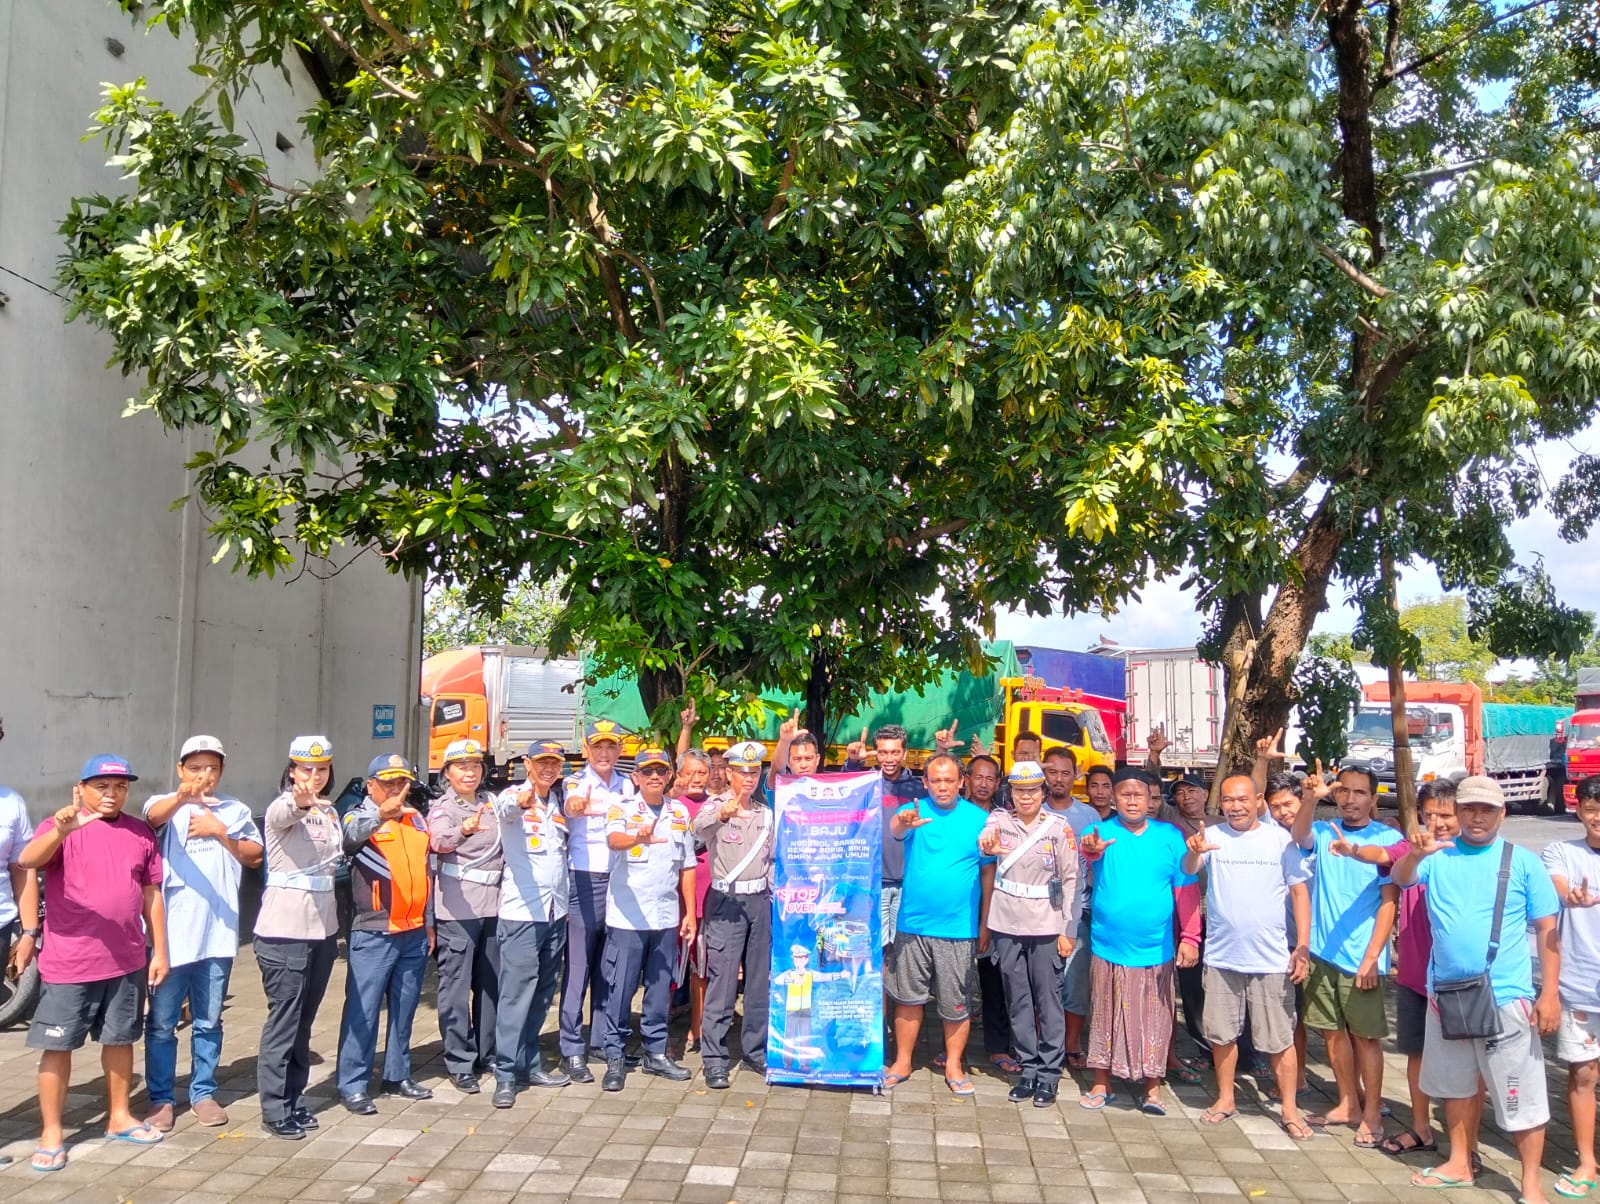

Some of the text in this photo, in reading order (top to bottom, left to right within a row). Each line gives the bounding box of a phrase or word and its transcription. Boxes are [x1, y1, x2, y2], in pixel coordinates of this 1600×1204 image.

[375, 708, 394, 720] KANTIN
[306, 817, 323, 825] NILA
[810, 826, 847, 836] BAJU
[845, 851, 870, 859] UMUM
[780, 889, 818, 900] STOP
[787, 903, 816, 913] OVER
[1506, 1076, 1520, 1112] ALL STAR
